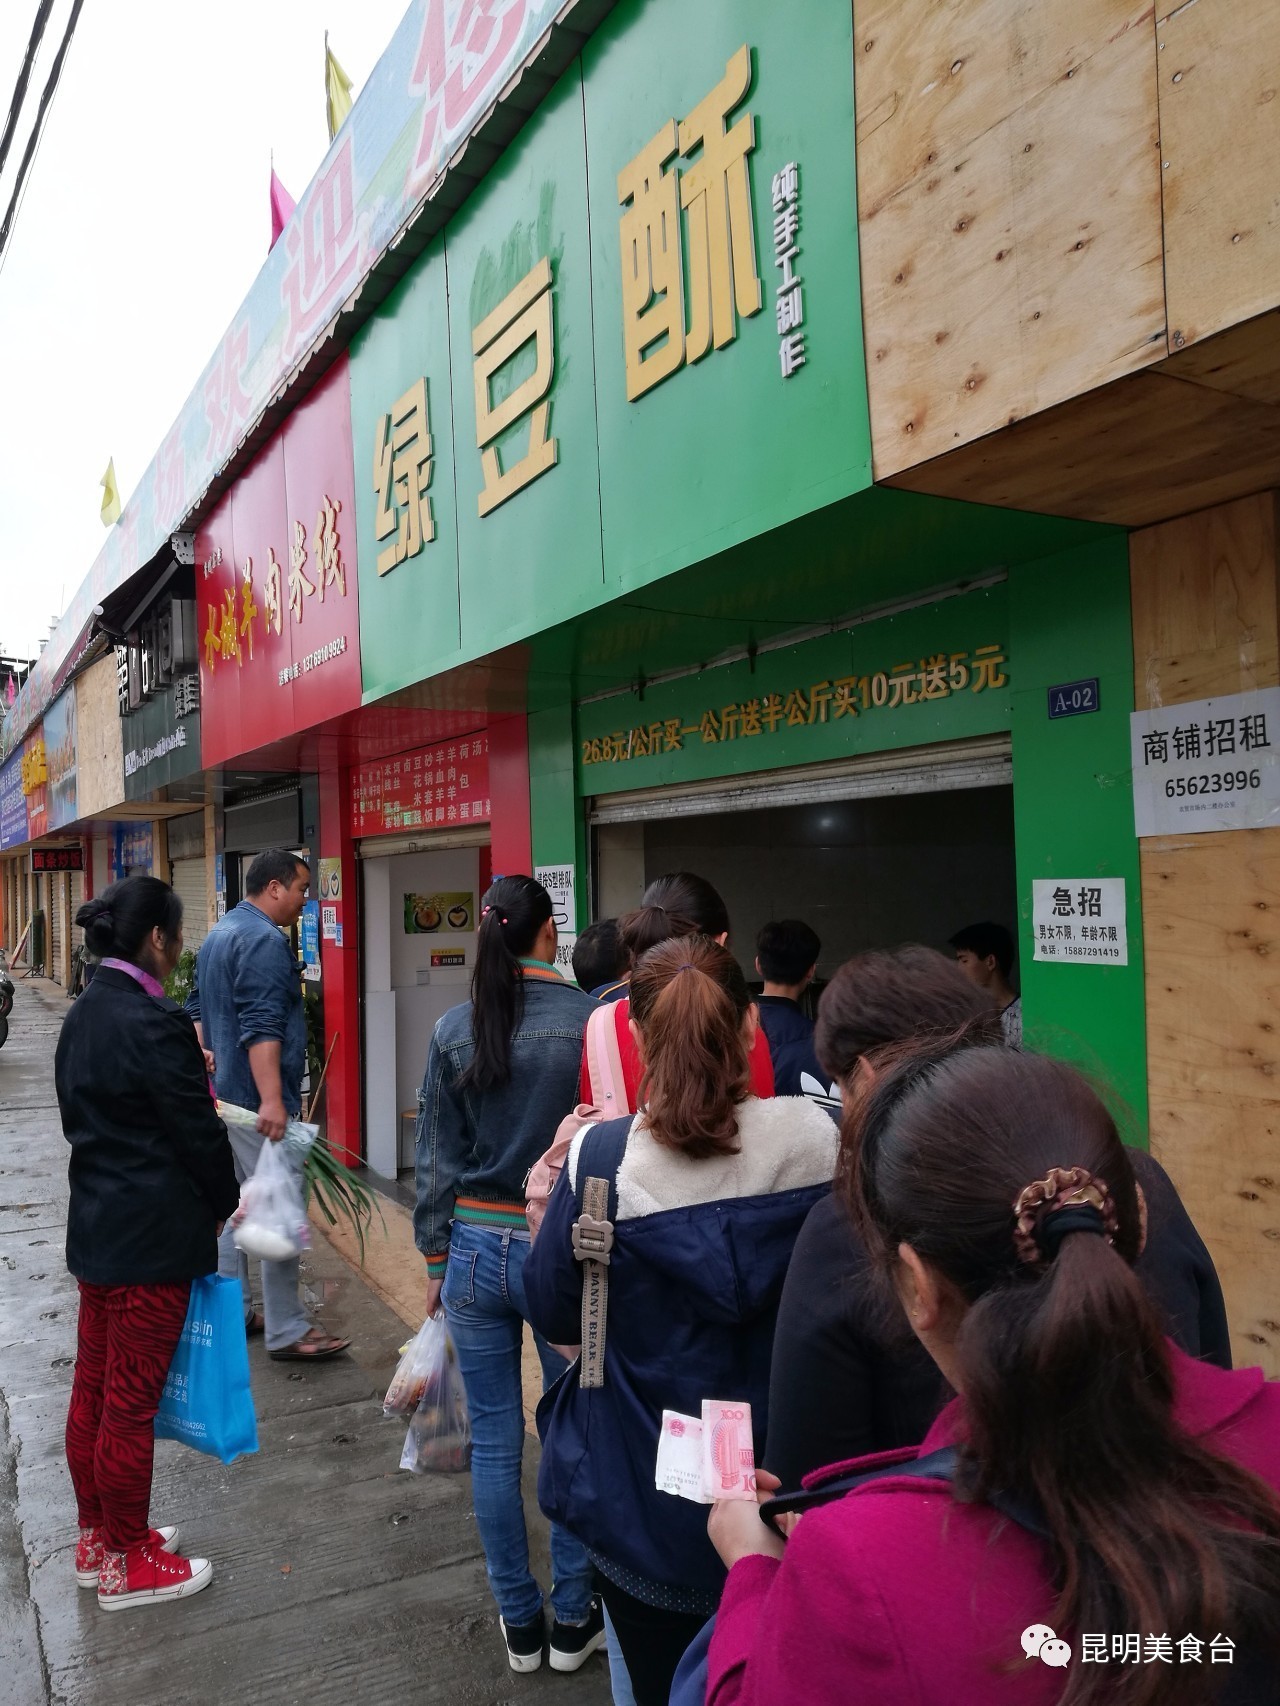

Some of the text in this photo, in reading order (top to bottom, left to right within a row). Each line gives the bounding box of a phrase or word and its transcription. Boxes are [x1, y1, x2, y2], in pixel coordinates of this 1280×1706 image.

[772, 161, 806, 378] 纯手工制作
[375, 43, 762, 578] 绿豆酥
[1055, 687, 1093, 712] A-02
[1142, 712, 1271, 766] 商铺招租
[1165, 768, 1261, 798] 65623996
[1052, 886, 1102, 917] 急招
[1039, 924, 1118, 942] 男女不限，年龄不限
[588, 1272, 600, 1317] DANNY
[588, 1323, 599, 1362] BEAR
